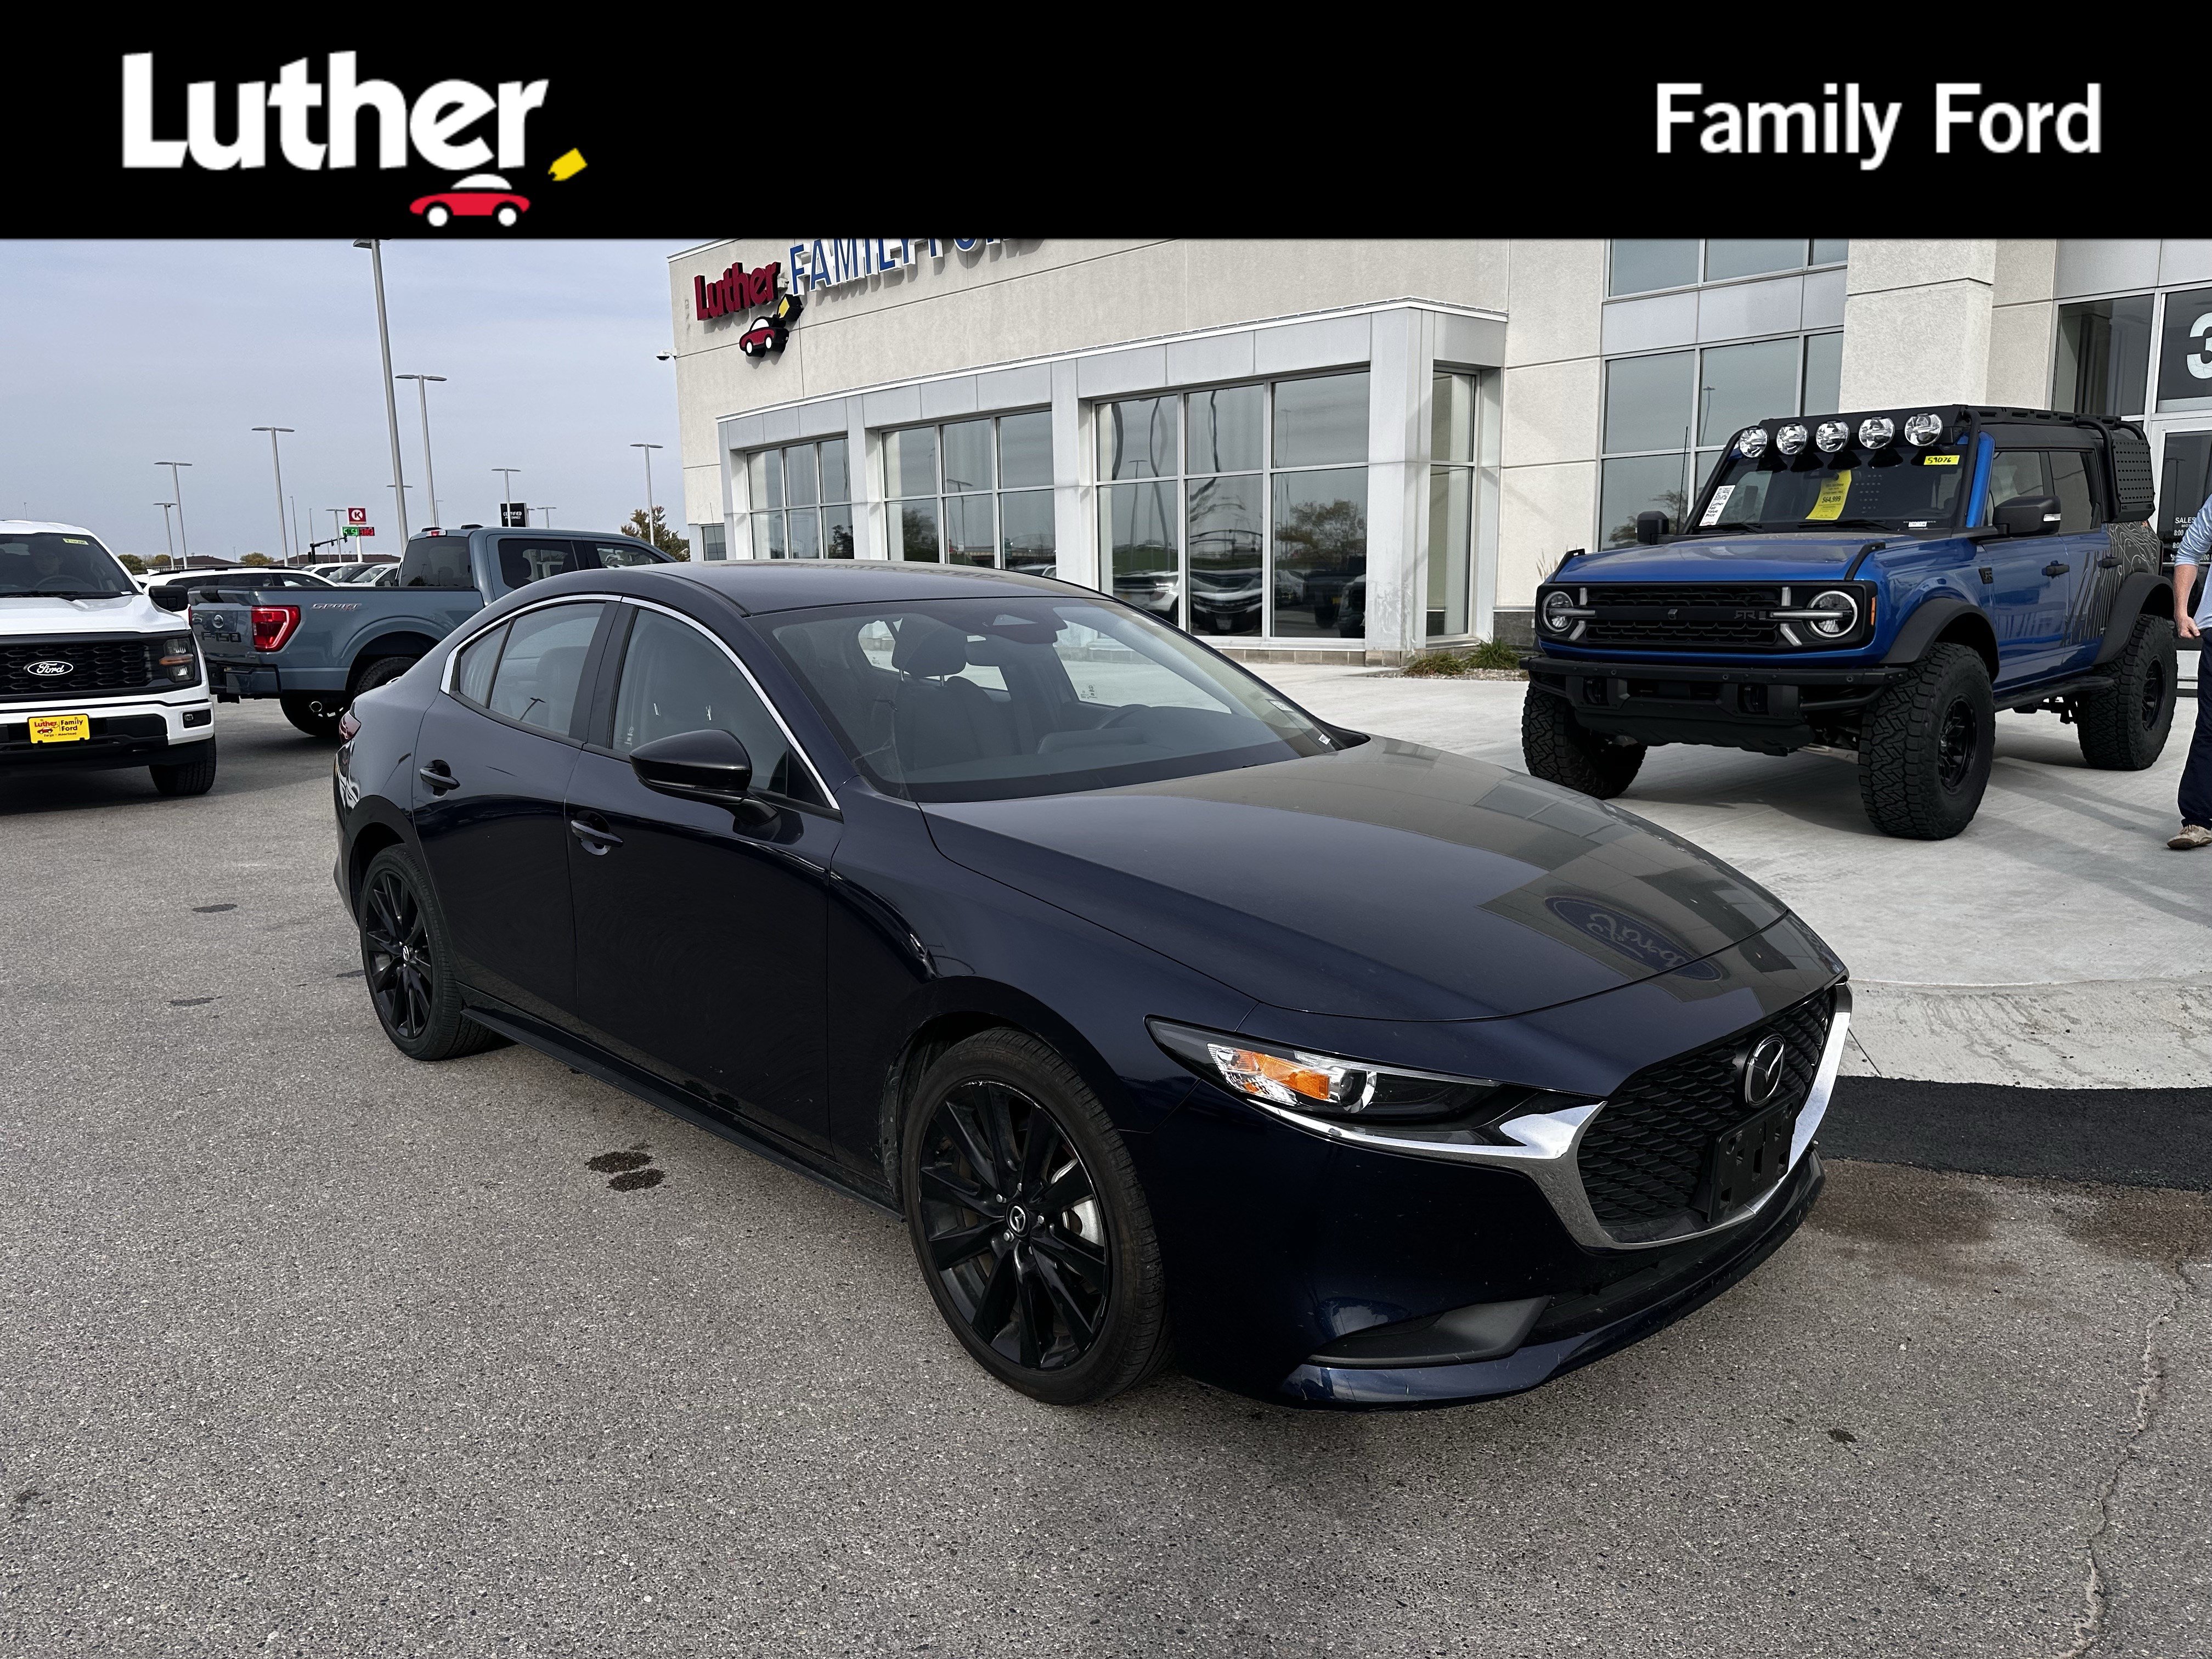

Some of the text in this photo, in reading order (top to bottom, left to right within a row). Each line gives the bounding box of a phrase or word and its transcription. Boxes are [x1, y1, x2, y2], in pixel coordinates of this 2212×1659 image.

[694, 262, 781, 321] Luther
[201, 631, 241, 643] F-150
[36, 663, 65, 673] Ford
